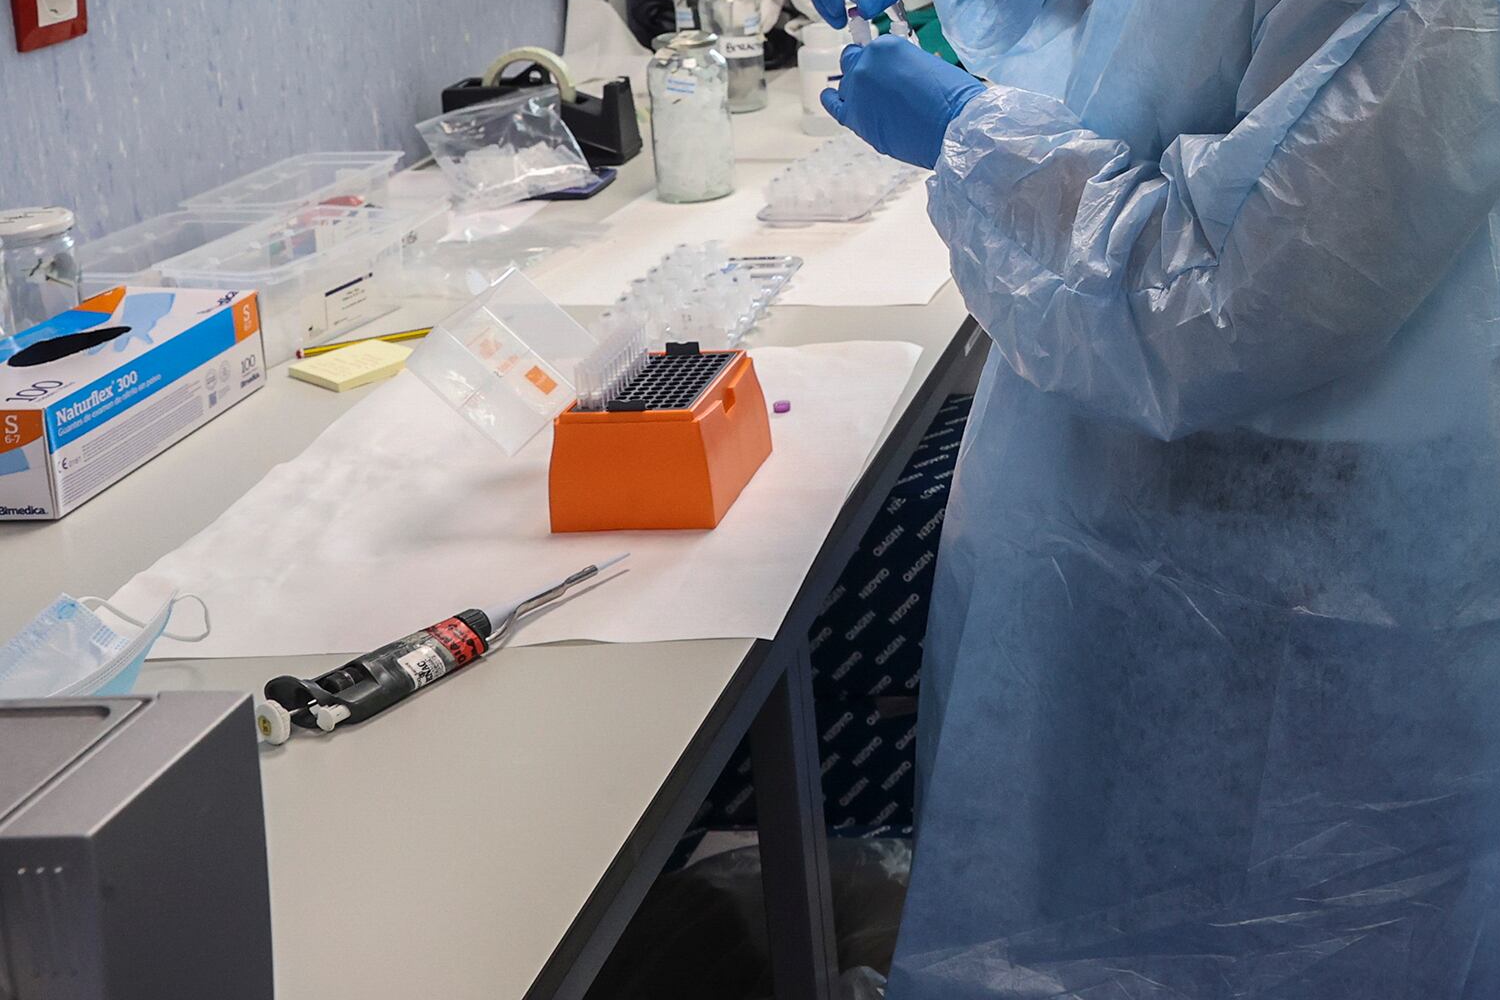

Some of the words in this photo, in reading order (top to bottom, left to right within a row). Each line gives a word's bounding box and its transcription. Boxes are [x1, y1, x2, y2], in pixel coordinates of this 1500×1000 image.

[243, 303, 251, 321] S
[241, 354, 256, 374] 100
[5, 380, 63, 402] 100
[116, 370, 138, 393] 300
[4, 434, 21, 444] 6-7
[5, 415, 19, 434] S
[873, 525, 905, 557] QIAGEN
[903, 550, 935, 582] QIAGEN
[858, 567, 890, 600] QIAGEN
[888, 592, 920, 625] QIAGEN
[845, 610, 876, 641] QIAGEN
[875, 634, 907, 666] QIAGEN
[832, 651, 863, 682] QIAGEN
[823, 711, 854, 743] QIAGEN
[852, 736, 883, 767] QIAGEN
[839, 776, 870, 807] QIAGEN
[881, 760, 912, 792] QIAGEN
